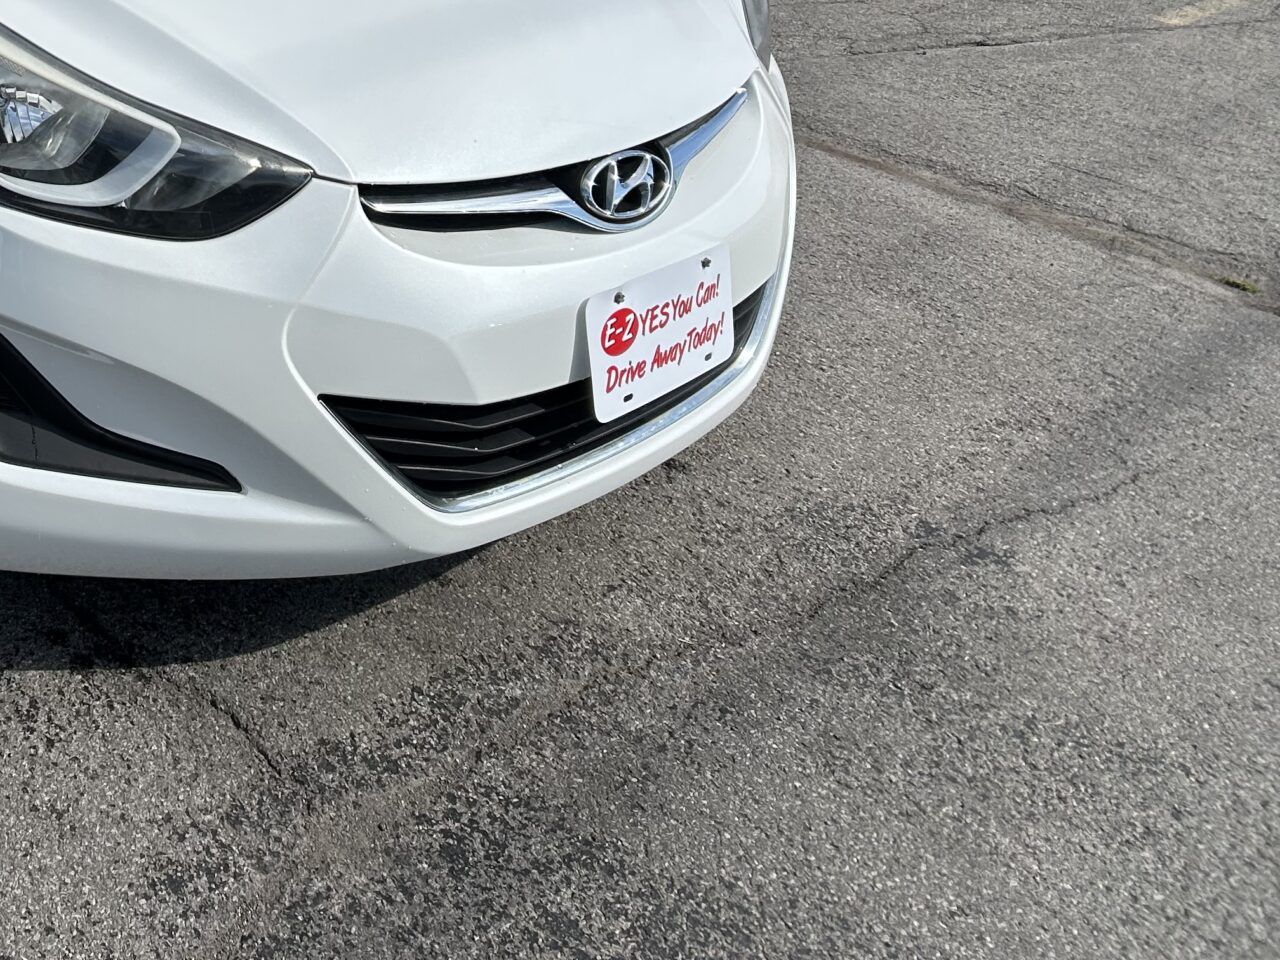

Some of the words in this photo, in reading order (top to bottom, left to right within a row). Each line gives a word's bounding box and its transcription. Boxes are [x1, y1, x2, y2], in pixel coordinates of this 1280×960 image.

[640, 302, 670, 336] YES
[671, 294, 693, 321] You
[696, 273, 721, 308] Can!
[606, 360, 646, 394] Drive
[650, 339, 687, 373] Away
[686, 311, 725, 352] Today!
